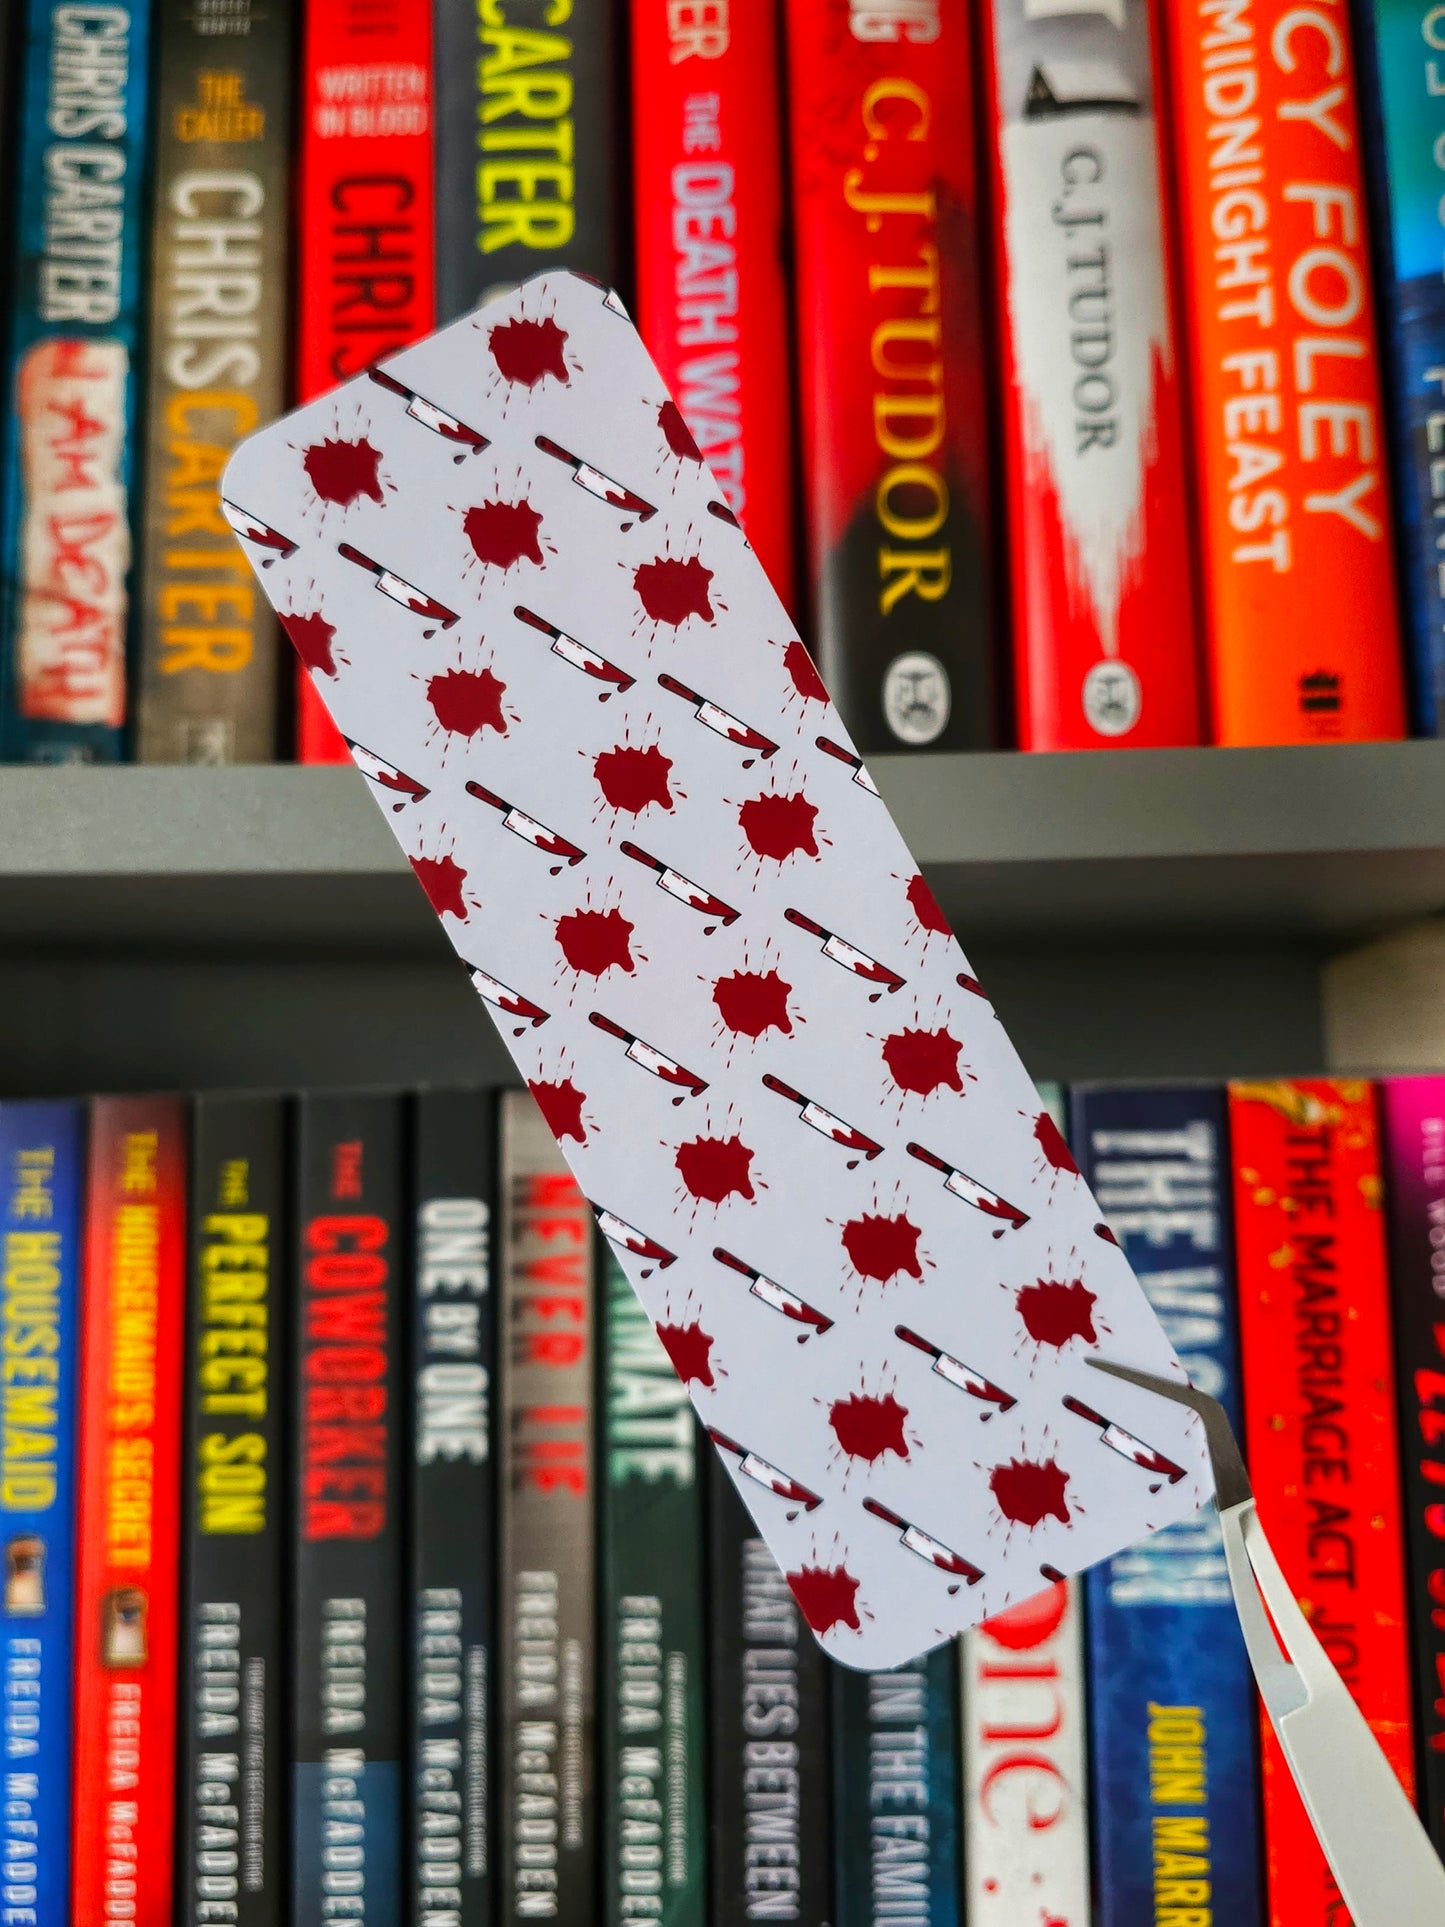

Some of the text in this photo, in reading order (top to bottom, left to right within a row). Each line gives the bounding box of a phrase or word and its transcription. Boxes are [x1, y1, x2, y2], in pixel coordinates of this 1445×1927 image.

[199, 71, 242, 108] THE
[316, 64, 428, 101] WRITTEN
[316, 103, 346, 138] IN
[476, 0, 575, 255] CARTER
[683, 92, 721, 154] THE
[39, 4, 130, 323] CHRIS CARTER
[671, 160, 738, 347] DEATH
[1199, 0, 1292, 574] MIDNIGHT FEAST
[1271, 0, 1383, 543] CY FOLEY
[159, 169, 264, 674] CHRIS CARTER
[868, 242, 952, 616] TUDOR
[1066, 246, 1118, 458] TUDOR
[36, 511, 118, 703] DEATH
[119, 1128, 159, 1192] THE
[1092, 1119, 1218, 1251] THE
[2, 1145, 62, 1514] THE HOUSEMAID
[202, 1159, 270, 1535] THE PERFECT SON
[303, 1139, 389, 1542] THE COWORKER
[416, 1196, 490, 1466] ONE BY ONE
[510, 1173, 586, 1500] NEVER LIE
[1284, 1126, 1356, 1590] THE MARRIAGE ACT
[106, 1437, 154, 1569] SECRET
[5, 1638, 41, 1760] FREIDA
[321, 1598, 366, 1735] FREIDA
[417, 1587, 462, 1725] FREIDA
[514, 1570, 558, 1708] FREIDA
[618, 1596, 662, 1735] FREIDA
[742, 1649, 799, 1737] LIES
[867, 1672, 928, 1723] IN
[106, 1682, 141, 1791] FREIDA
[197, 1602, 240, 1927] FREIDA McFADDE
[869, 1725, 929, 1809] THE
[1147, 1701, 1208, 1804] JOHN
[743, 1741, 799, 1920] BETWEEN
